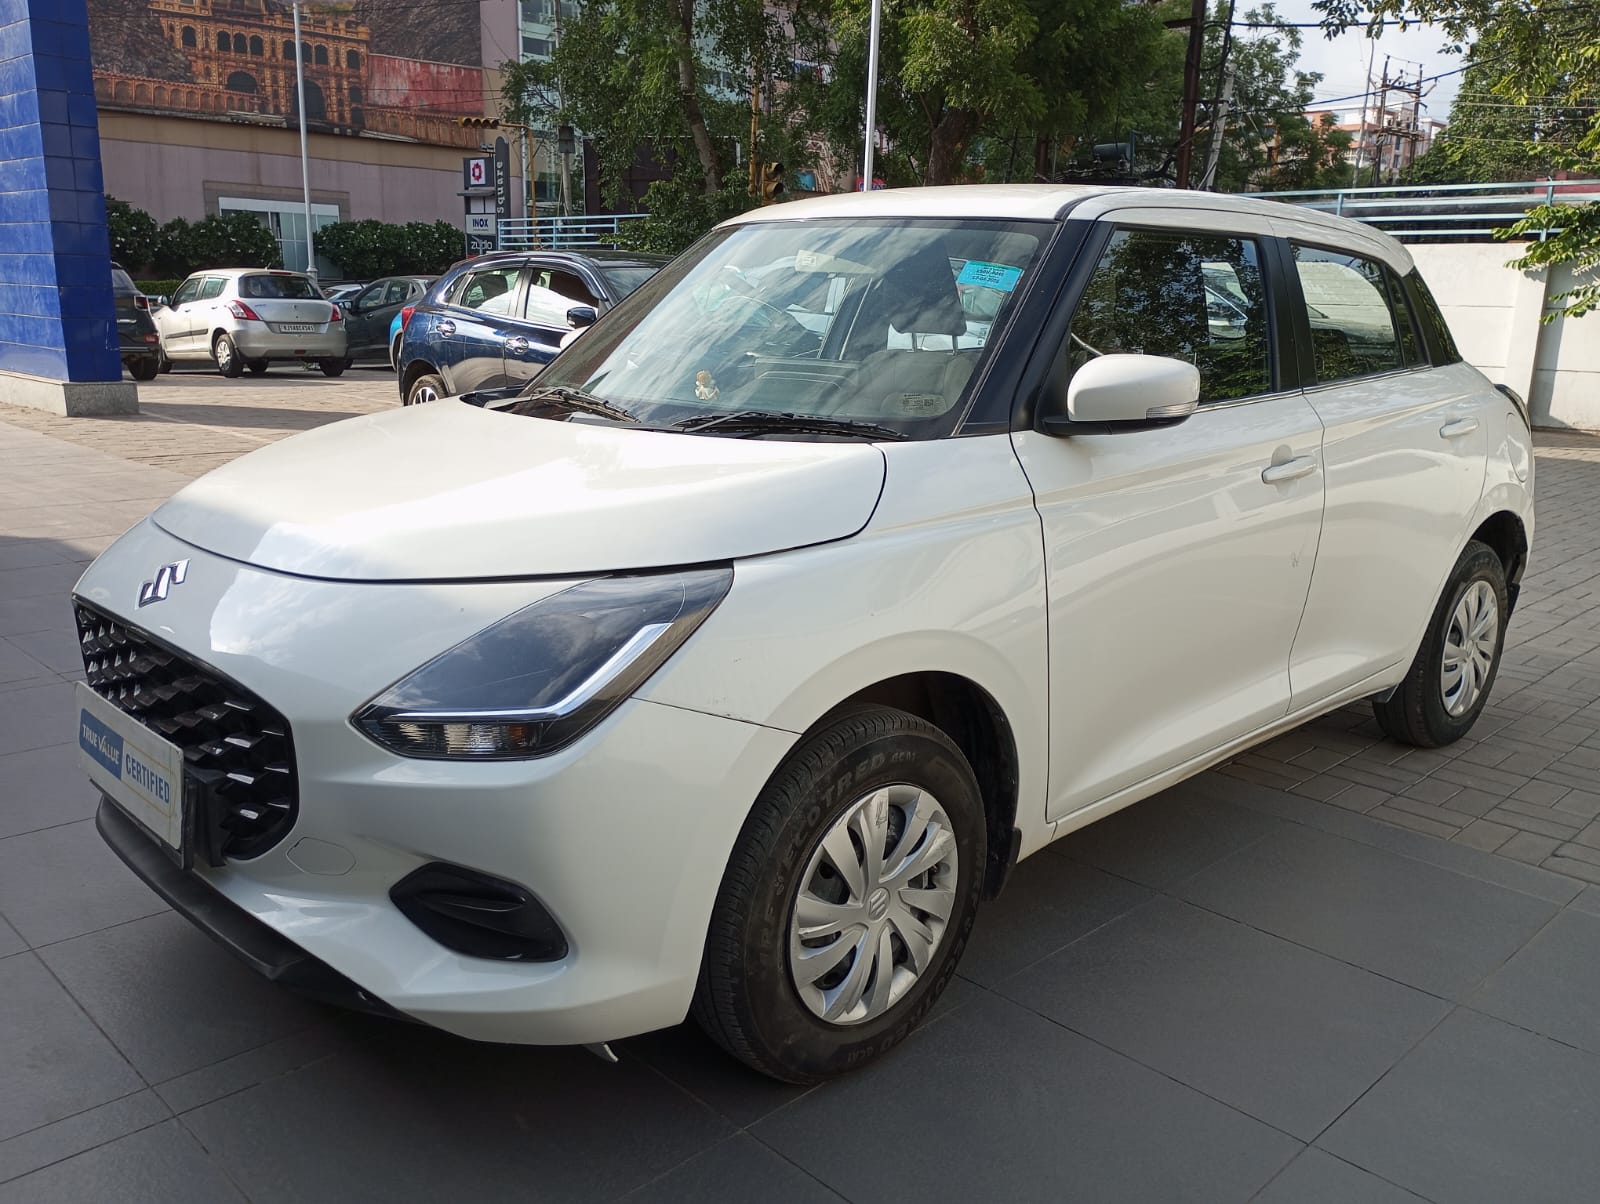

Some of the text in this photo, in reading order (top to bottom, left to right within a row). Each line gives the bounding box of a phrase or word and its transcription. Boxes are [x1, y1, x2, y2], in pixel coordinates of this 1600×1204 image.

[496, 161, 505, 214] square
[472, 218, 489, 227] INOX
[82, 724, 120, 764] TRUE VALUE
[125, 752, 170, 804] CERTIFIED
